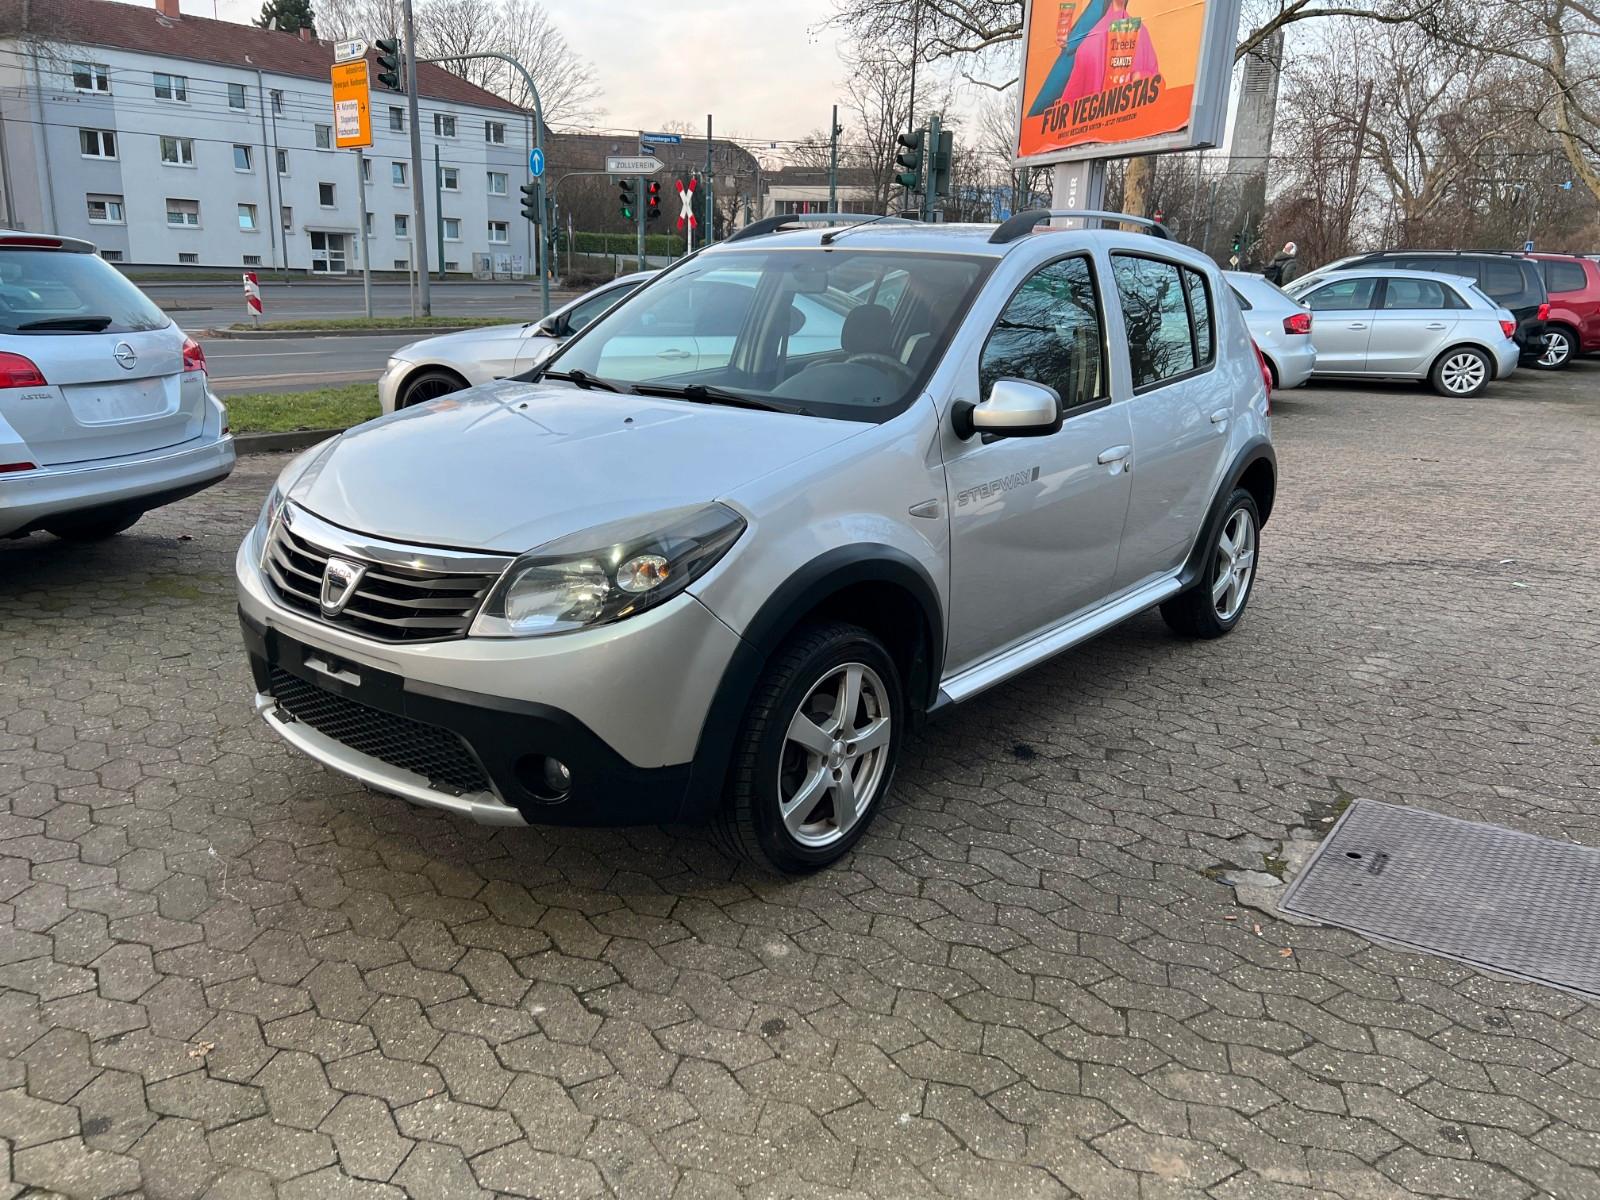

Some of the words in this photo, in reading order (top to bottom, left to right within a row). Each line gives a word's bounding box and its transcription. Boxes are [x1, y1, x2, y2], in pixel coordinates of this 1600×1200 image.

[1110, 56, 1133, 67] PEANUTS
[1041, 98, 1070, 134] FÜR
[1072, 73, 1162, 126] VEGANISTAS
[616, 161, 655, 169] ZOLLVEREIN
[957, 469, 1031, 507] STEPWAY
[327, 566, 353, 580] DACIA
